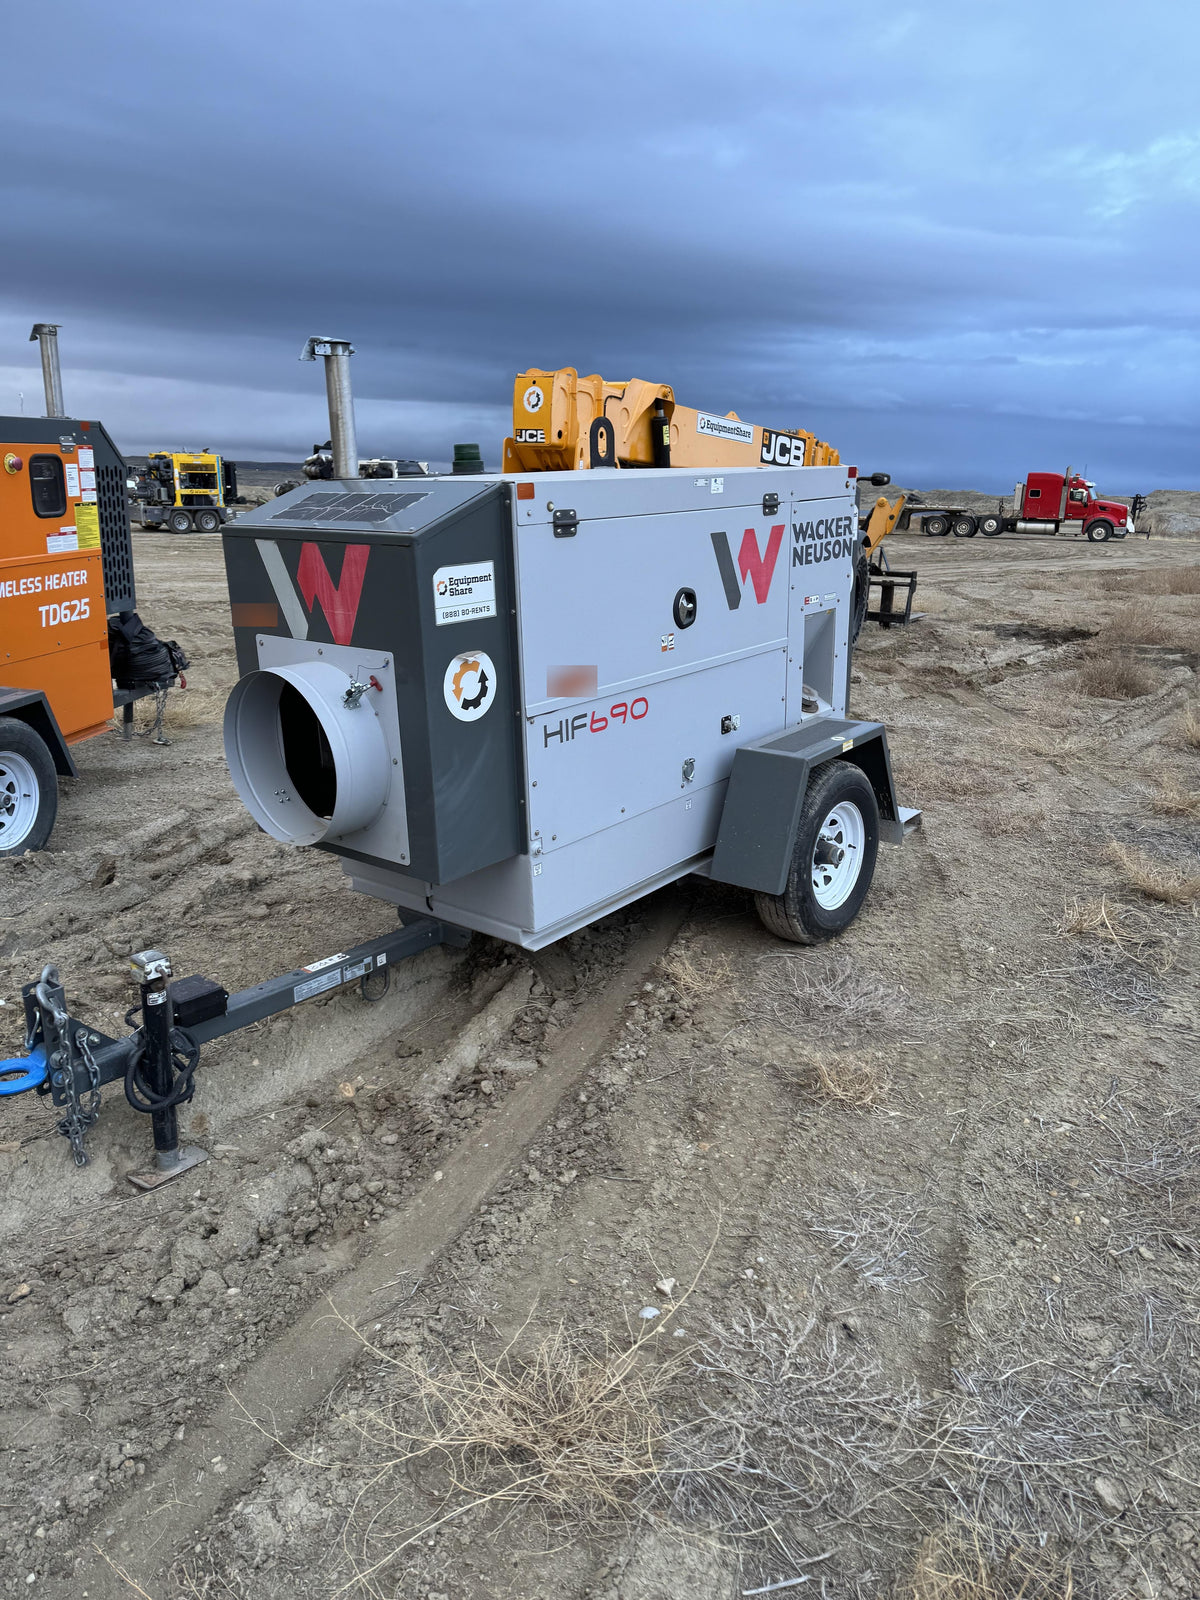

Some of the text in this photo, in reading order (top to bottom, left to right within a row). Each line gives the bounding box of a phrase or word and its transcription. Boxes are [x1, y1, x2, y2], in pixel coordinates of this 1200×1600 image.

[706, 419, 751, 439] EquipmentShare
[762, 433, 805, 467] JCB
[792, 515, 853, 544] WACKER
[792, 538, 852, 568] NEUSON
[45, 569, 88, 591] HEATER
[449, 573, 492, 586] Equipment
[449, 586, 472, 596] Share
[38, 597, 90, 628] TD625
[543, 696, 649, 749] HIF690
